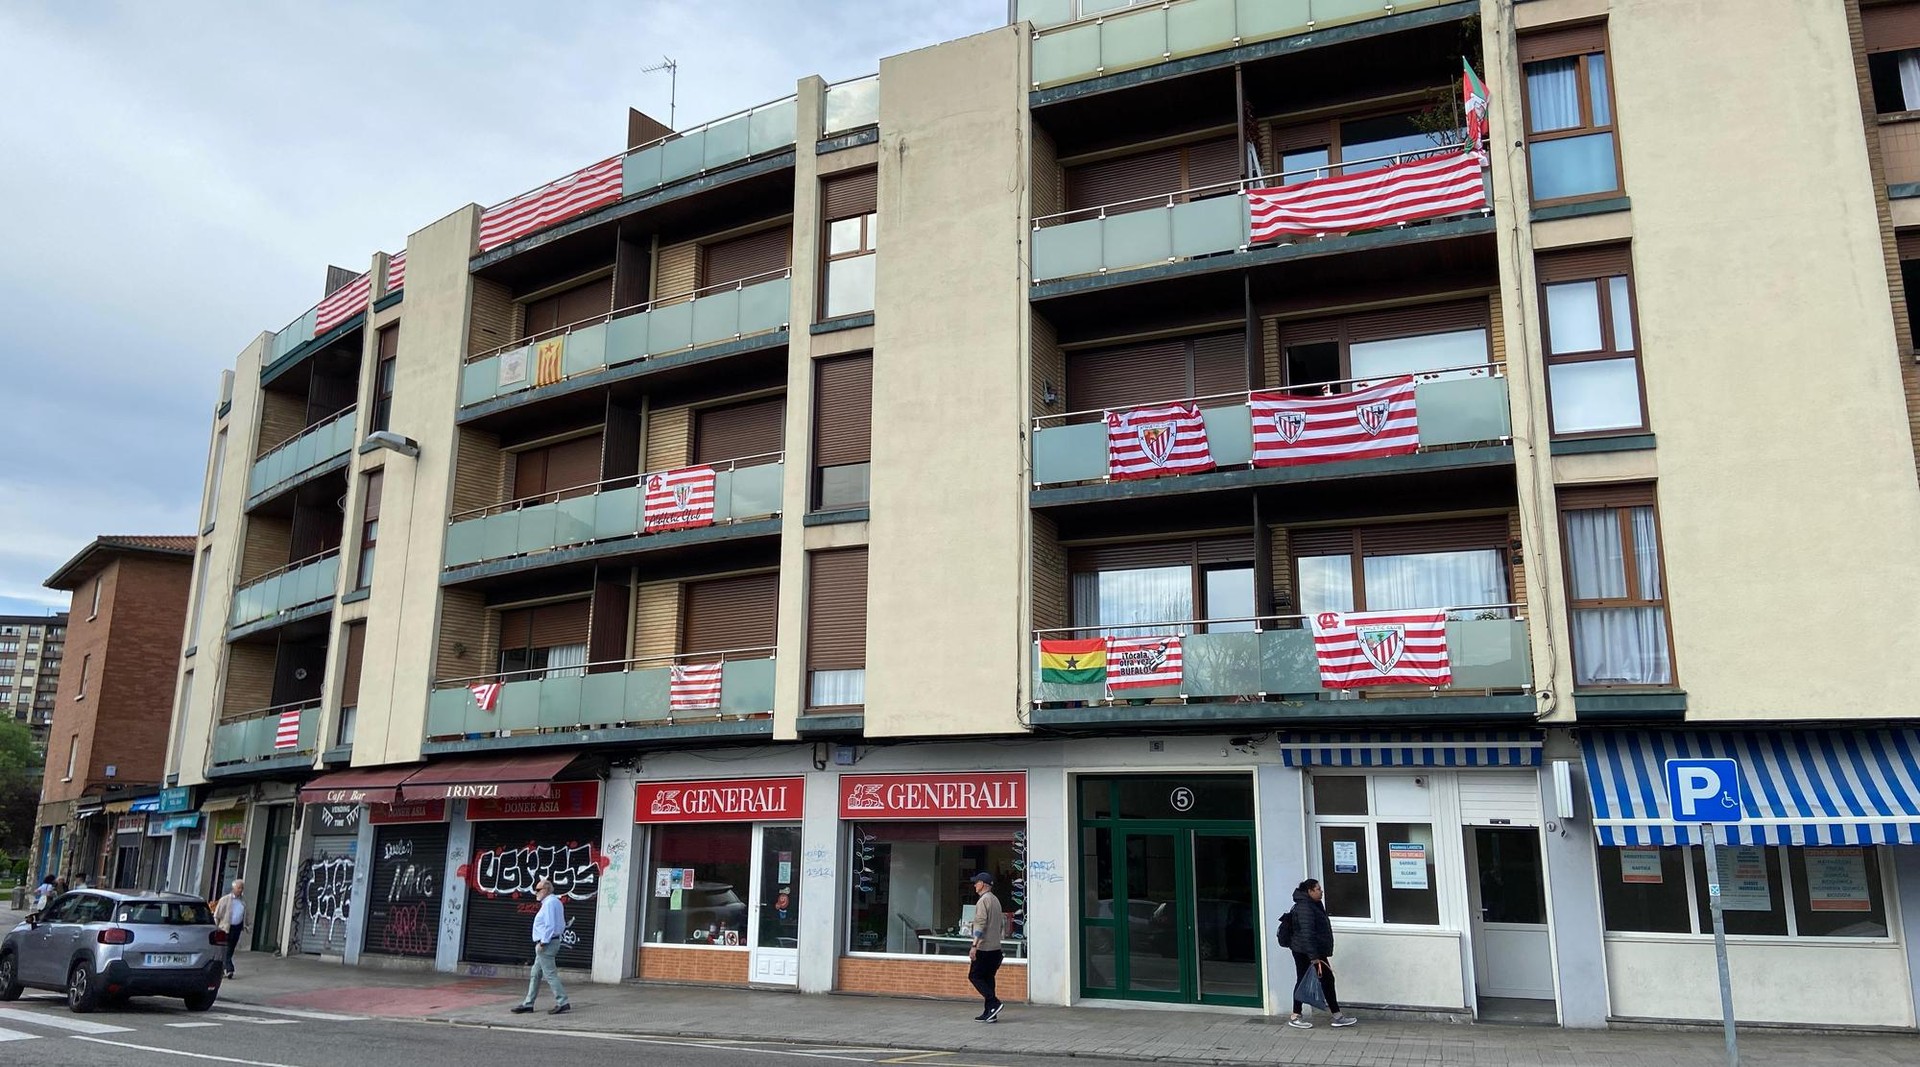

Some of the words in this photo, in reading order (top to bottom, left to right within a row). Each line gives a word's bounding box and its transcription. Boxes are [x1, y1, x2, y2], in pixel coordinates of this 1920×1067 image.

[327, 790, 346, 803] Café
[350, 790, 366, 800] Bar
[446, 785, 499, 797] IRINTZI
[886, 781, 1019, 810] GENERALI
[1677, 767, 1721, 815] P
[682, 786, 787, 814] GENERALI
[1176, 791, 1189, 808] 5
[331, 805, 350, 813] VENDING
[412, 806, 426, 816] ASIA
[504, 803, 537, 813] DONER
[538, 803, 560, 813] ASIA
[334, 819, 345, 827] TIME
